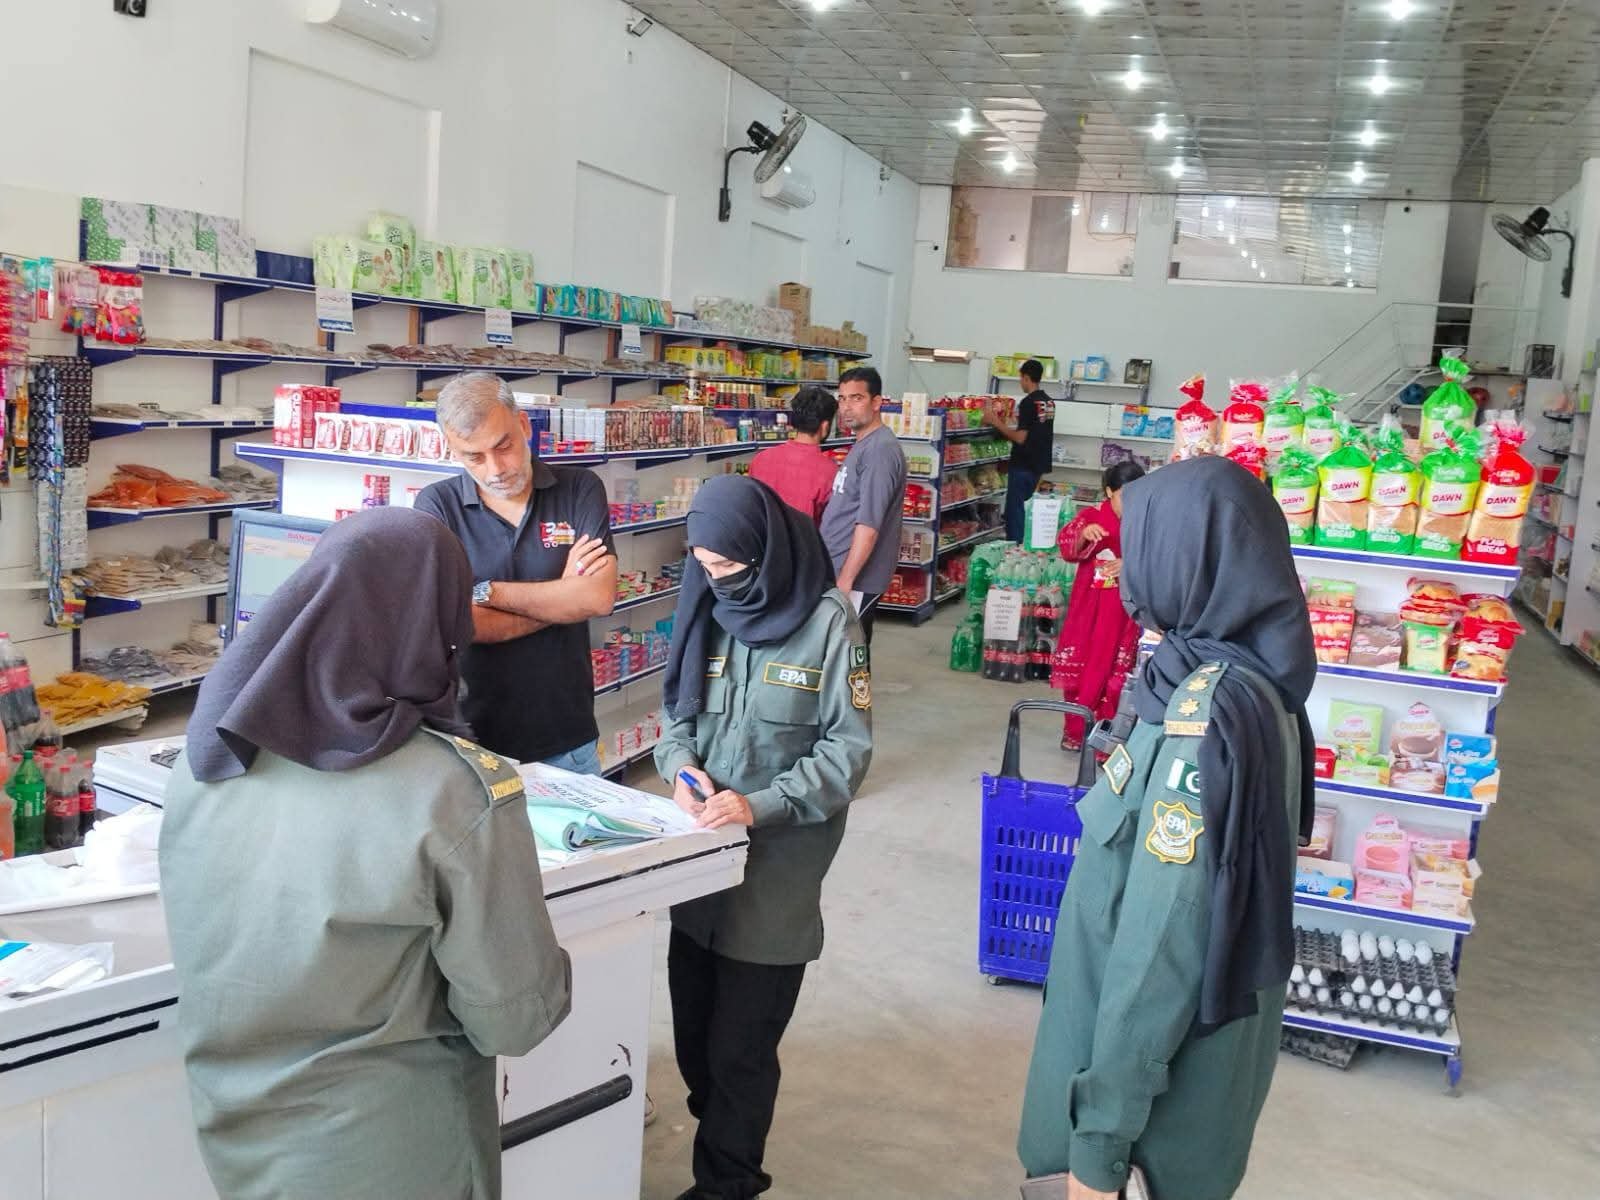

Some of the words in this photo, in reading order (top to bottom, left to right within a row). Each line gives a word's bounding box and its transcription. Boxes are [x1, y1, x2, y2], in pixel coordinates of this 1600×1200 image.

[1331, 480, 1360, 491] DAWN
[1377, 485, 1407, 496] DAWN
[1281, 496, 1305, 505] DAWN
[1432, 493, 1463, 503] DAWN
[1486, 496, 1518, 505] DAWN
[1476, 544, 1507, 555] BREAD
[779, 669, 808, 686] EPA
[1165, 813, 1188, 831] EPA
